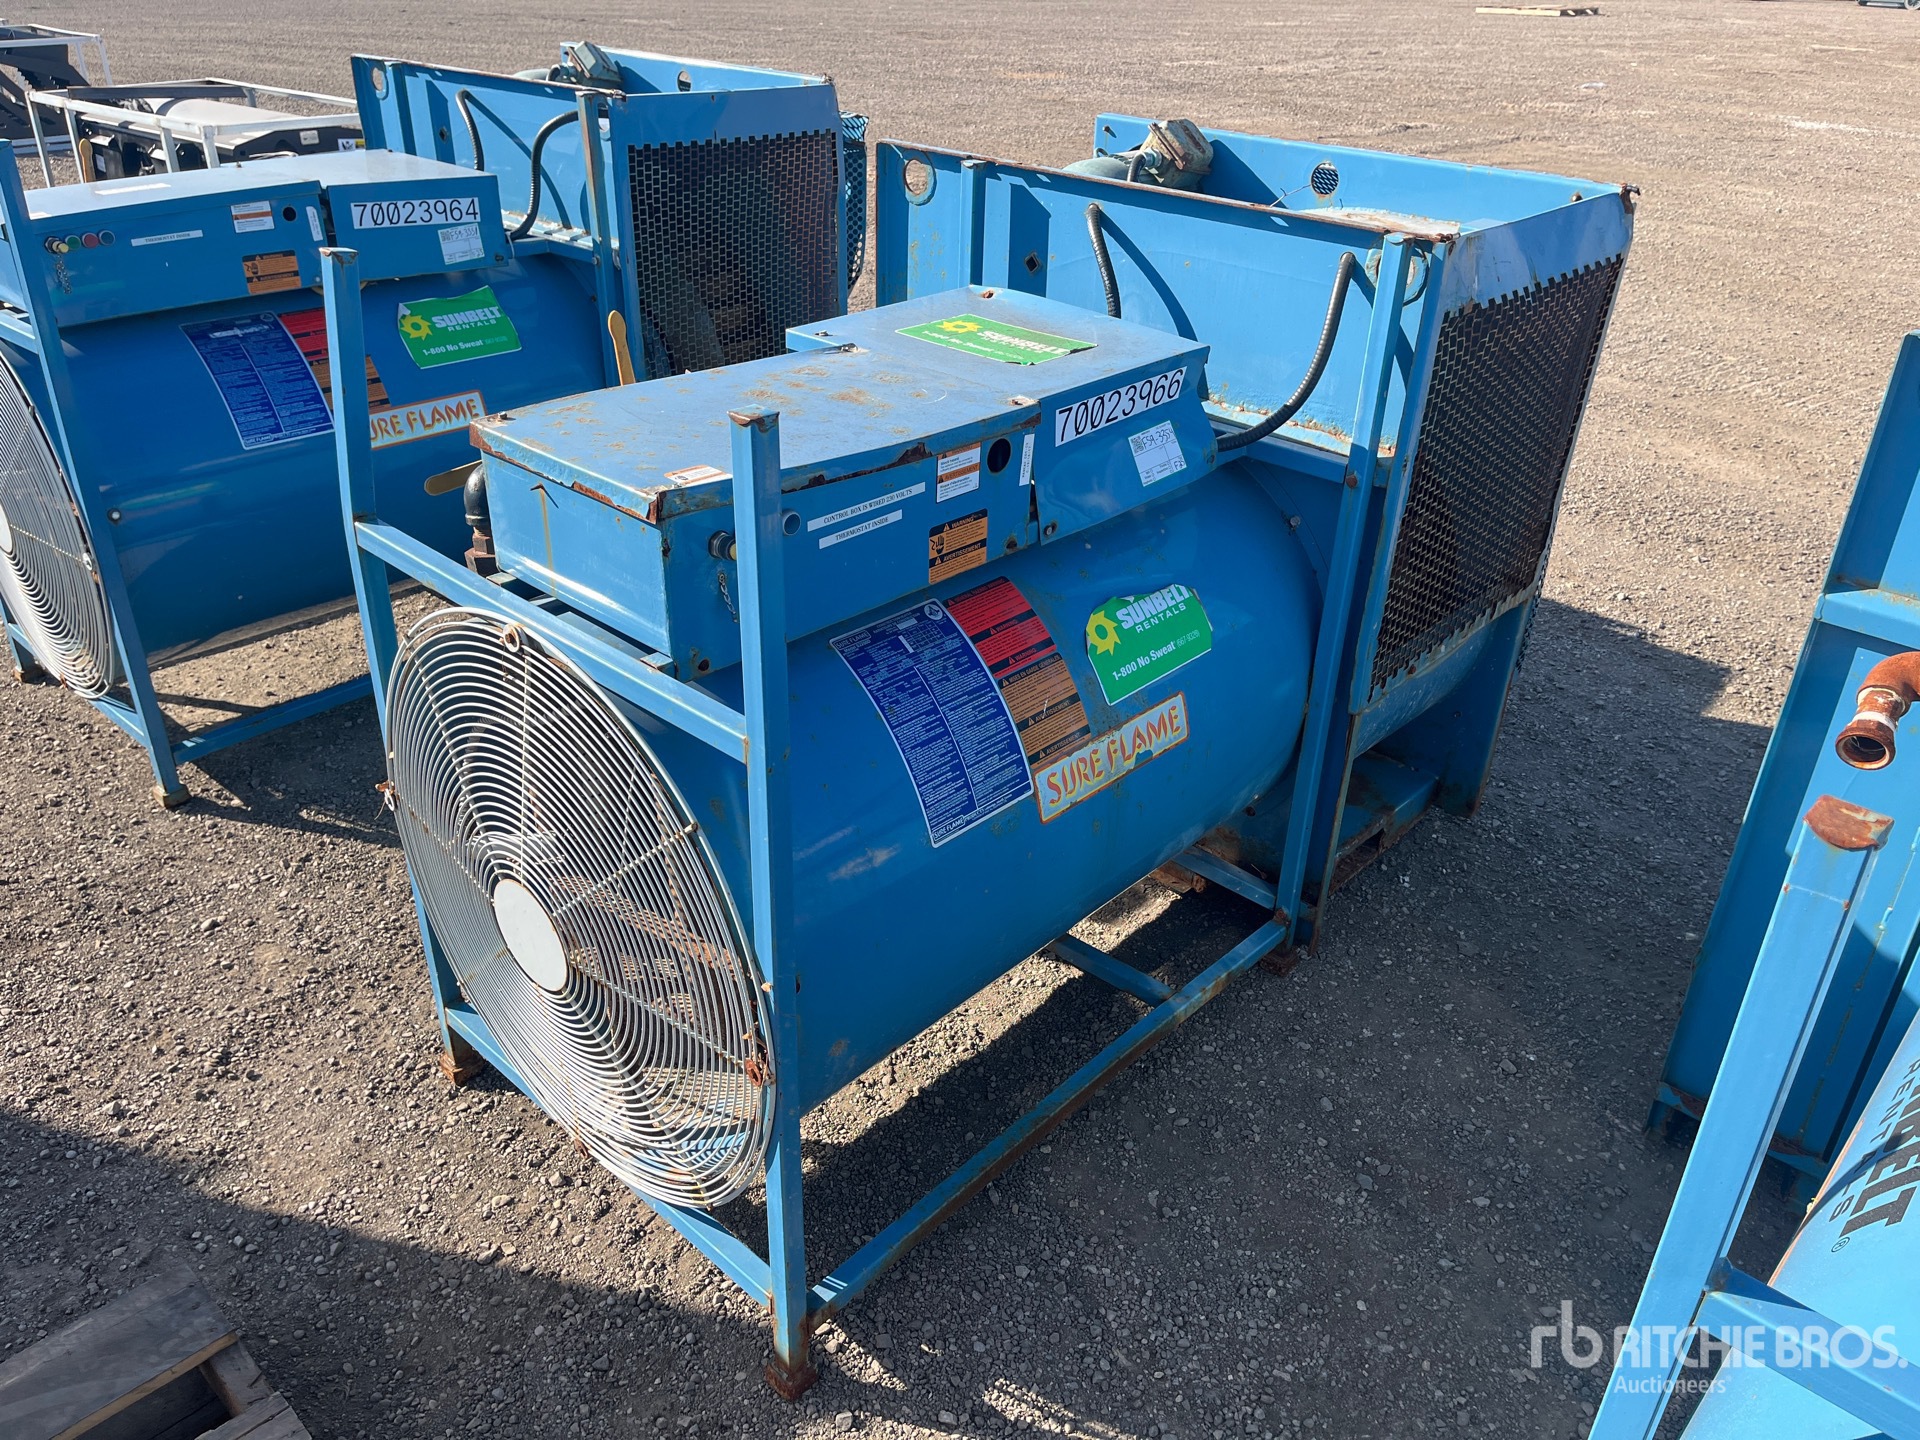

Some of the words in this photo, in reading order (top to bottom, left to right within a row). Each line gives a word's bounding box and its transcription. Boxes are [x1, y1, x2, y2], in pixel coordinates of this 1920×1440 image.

[354, 199, 479, 227] 70023964
[431, 306, 502, 328] SUNBELT
[447, 319, 497, 332] RENTALS
[422, 345, 446, 356] 1-800
[446, 343, 459, 352] No
[458, 339, 484, 349] Sweat
[406, 398, 480, 434] FLAME
[1058, 368, 1184, 442] 70023966
[823, 511, 849, 524] CONTROL
[850, 506, 862, 515] BOX
[862, 503, 868, 511] IS
[868, 497, 885, 509] WIRED
[895, 488, 913, 500] VOLTS
[835, 522, 872, 541] THERMOSTAT
[871, 516, 889, 528] INSIDE
[951, 515, 975, 529] WARNING
[943, 542, 981, 562] AVERTISSEMENT
[1115, 584, 1190, 629] SUNBELT
[1135, 602, 1187, 634] RENTALS
[1112, 661, 1138, 681] 1-800
[1137, 655, 1150, 668] No
[1150, 641, 1176, 661] Sweat
[1046, 732, 1080, 755] AVERTISSEMENT
[1046, 748, 1104, 806] SURE
[1106, 705, 1180, 774] FLAME
[946, 818, 964, 832] FLAME
